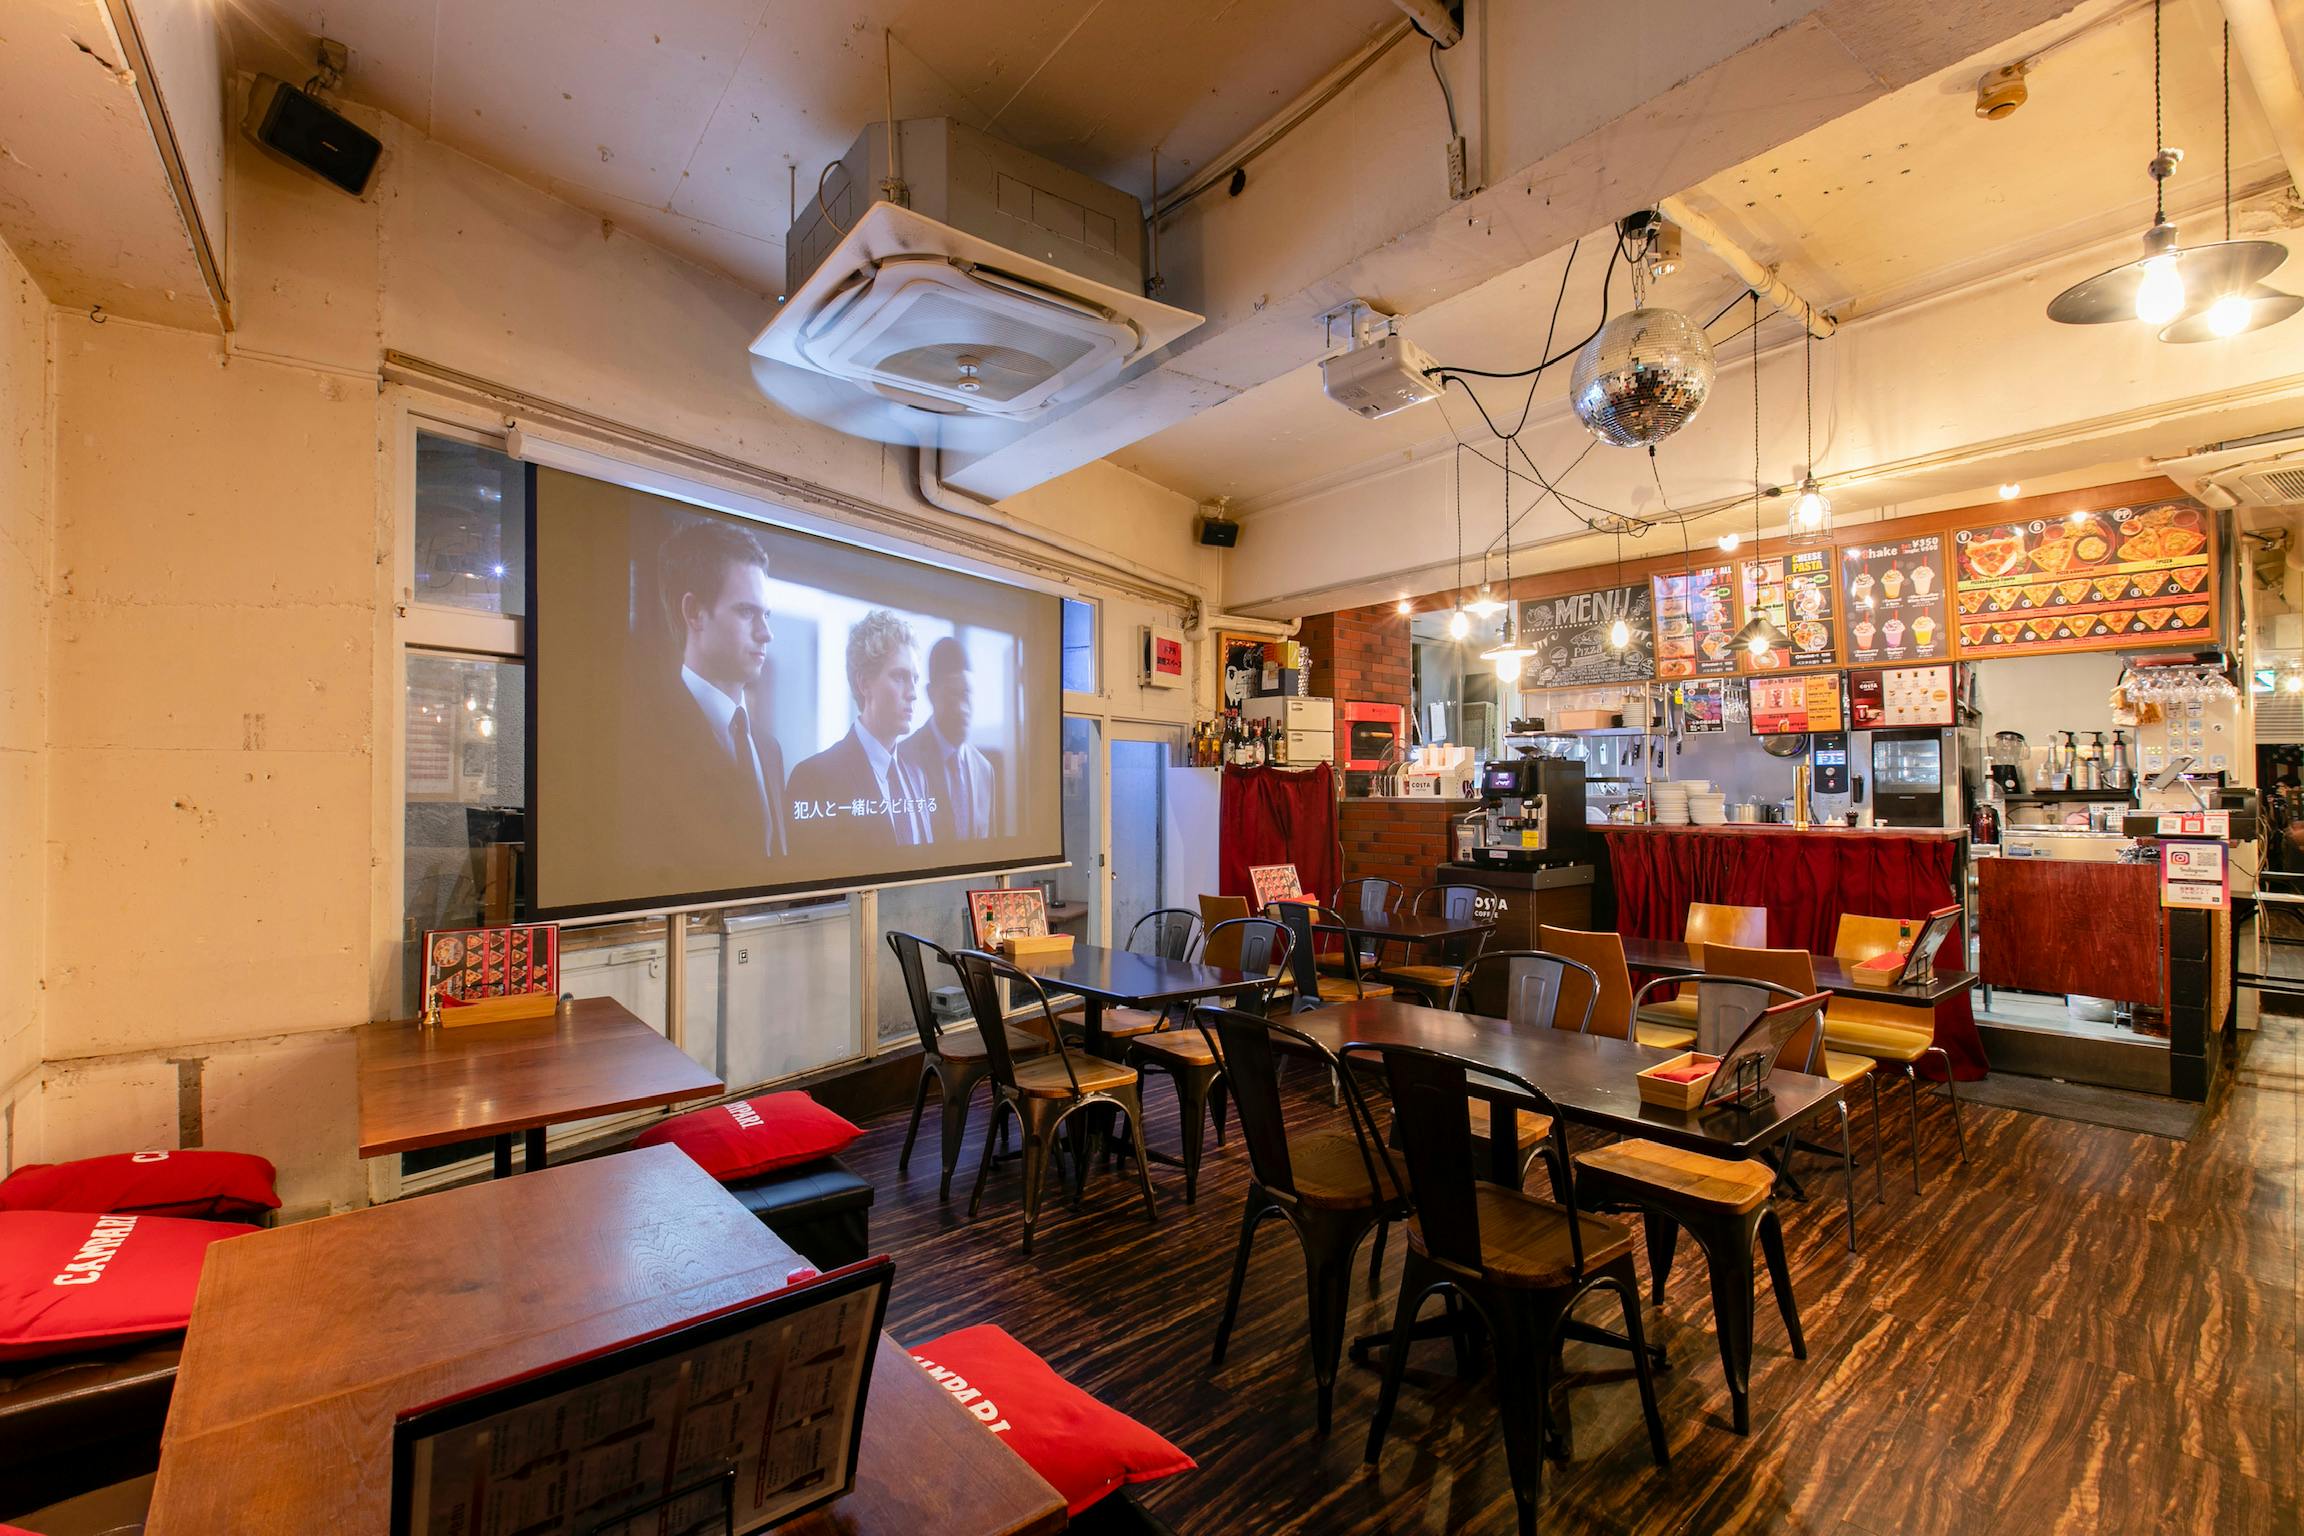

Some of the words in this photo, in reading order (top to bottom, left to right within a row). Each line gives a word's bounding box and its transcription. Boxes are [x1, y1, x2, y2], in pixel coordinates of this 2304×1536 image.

[1791, 551, 1823, 562] CHEESE
[1862, 547, 1898, 560] Shake
[1792, 560, 1823, 573] PASTA
[1696, 574, 1733, 585] PASTA
[1555, 588, 1632, 625] MENU
[794, 798, 937, 820] 犯人と一緒にクビにする
[1475, 896, 1508, 910] OSTA
[1474, 910, 1499, 919] COFFE
[723, 1100, 764, 1130] MPARI
[53, 1215, 138, 1286] CAMPARI
